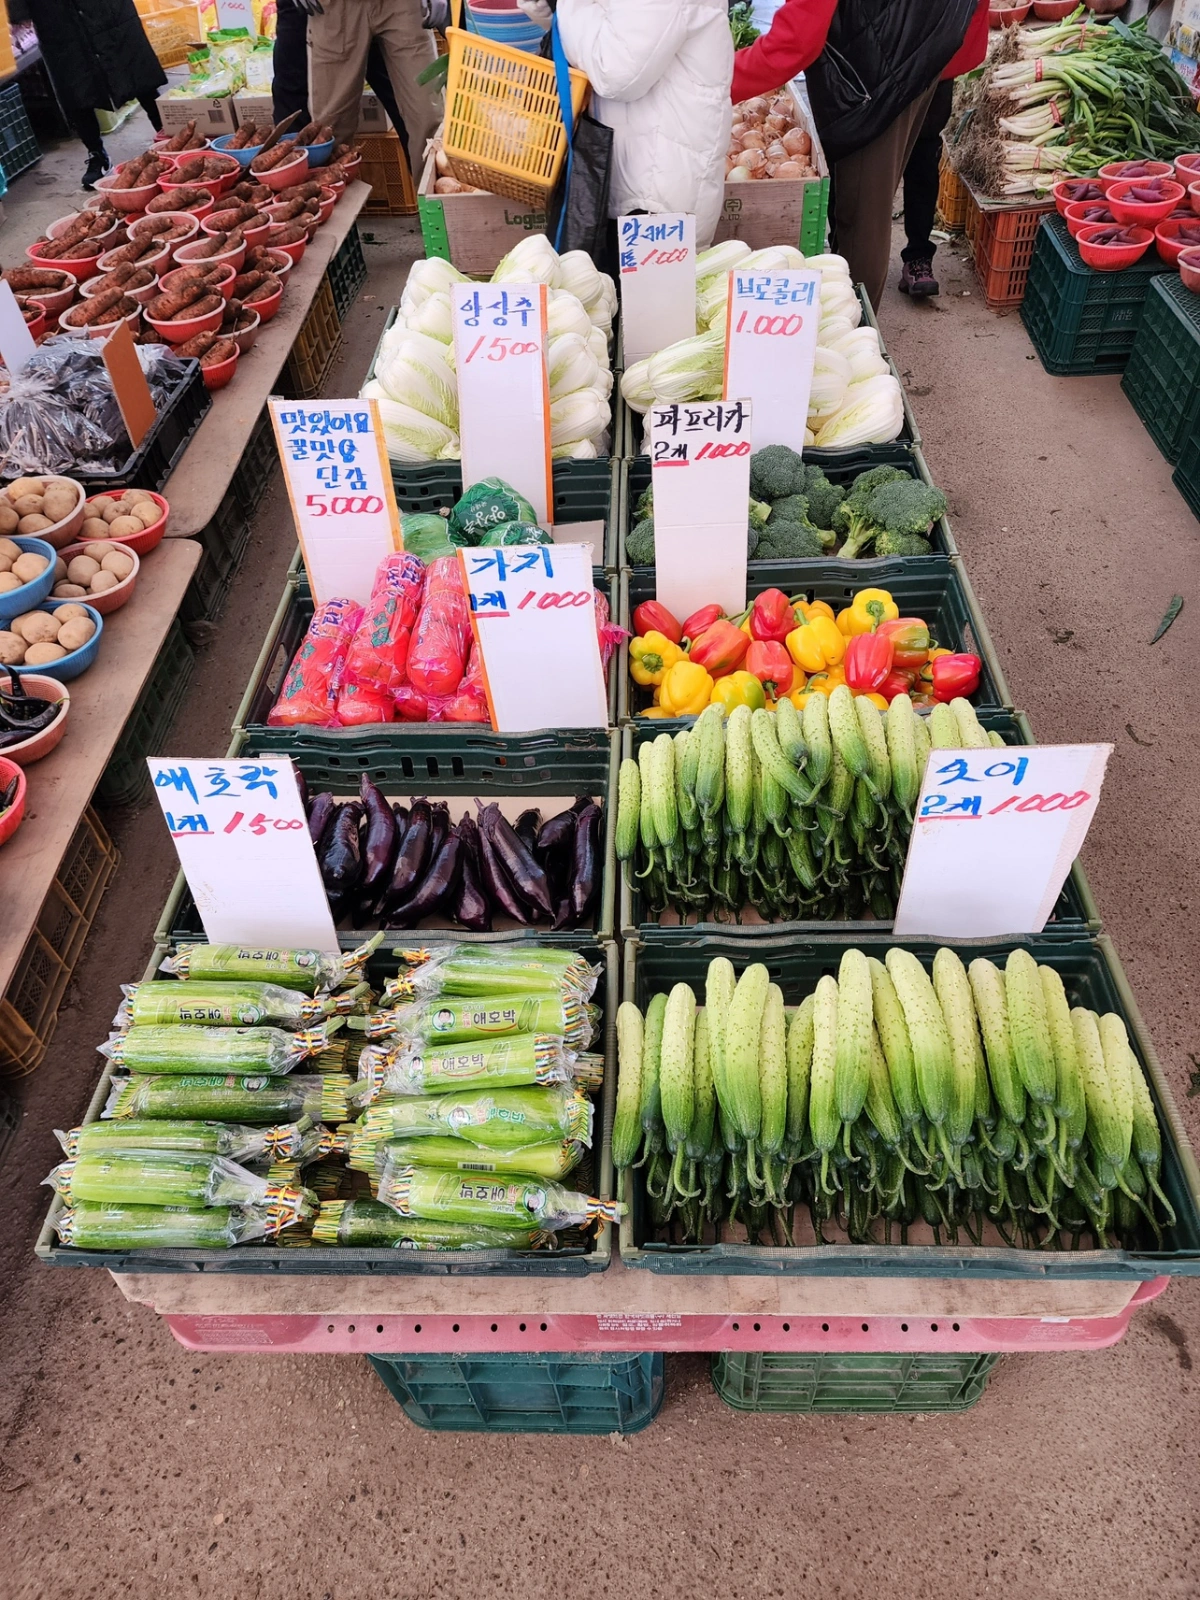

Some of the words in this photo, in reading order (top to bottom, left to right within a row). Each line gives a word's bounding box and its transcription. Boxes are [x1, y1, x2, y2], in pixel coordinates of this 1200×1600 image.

[503, 206, 548, 230] Logis
[736, 276, 816, 306] 브로콜리
[460, 291, 536, 327] 양상추
[280, 409, 375, 436] 맛있어요
[652, 401, 750, 436] 파프리카
[654, 441, 688, 461] 2개
[316, 465, 368, 491] 단감
[469, 546, 554, 582] 가지
[468, 590, 507, 612] 1개
[935, 756, 1029, 786] 오이
[154, 765, 279, 805] 애호박
[921, 794, 982, 816] 2개
[165, 811, 209, 832] 1개
[237, 949, 280, 961] 애호박
[178, 1007, 222, 1021] 애호박
[473, 1008, 517, 1026] 애호박
[441, 1052, 486, 1072] 애호박
[180, 1075, 225, 1087] 애호박
[460, 1182, 506, 1202] 애호박
